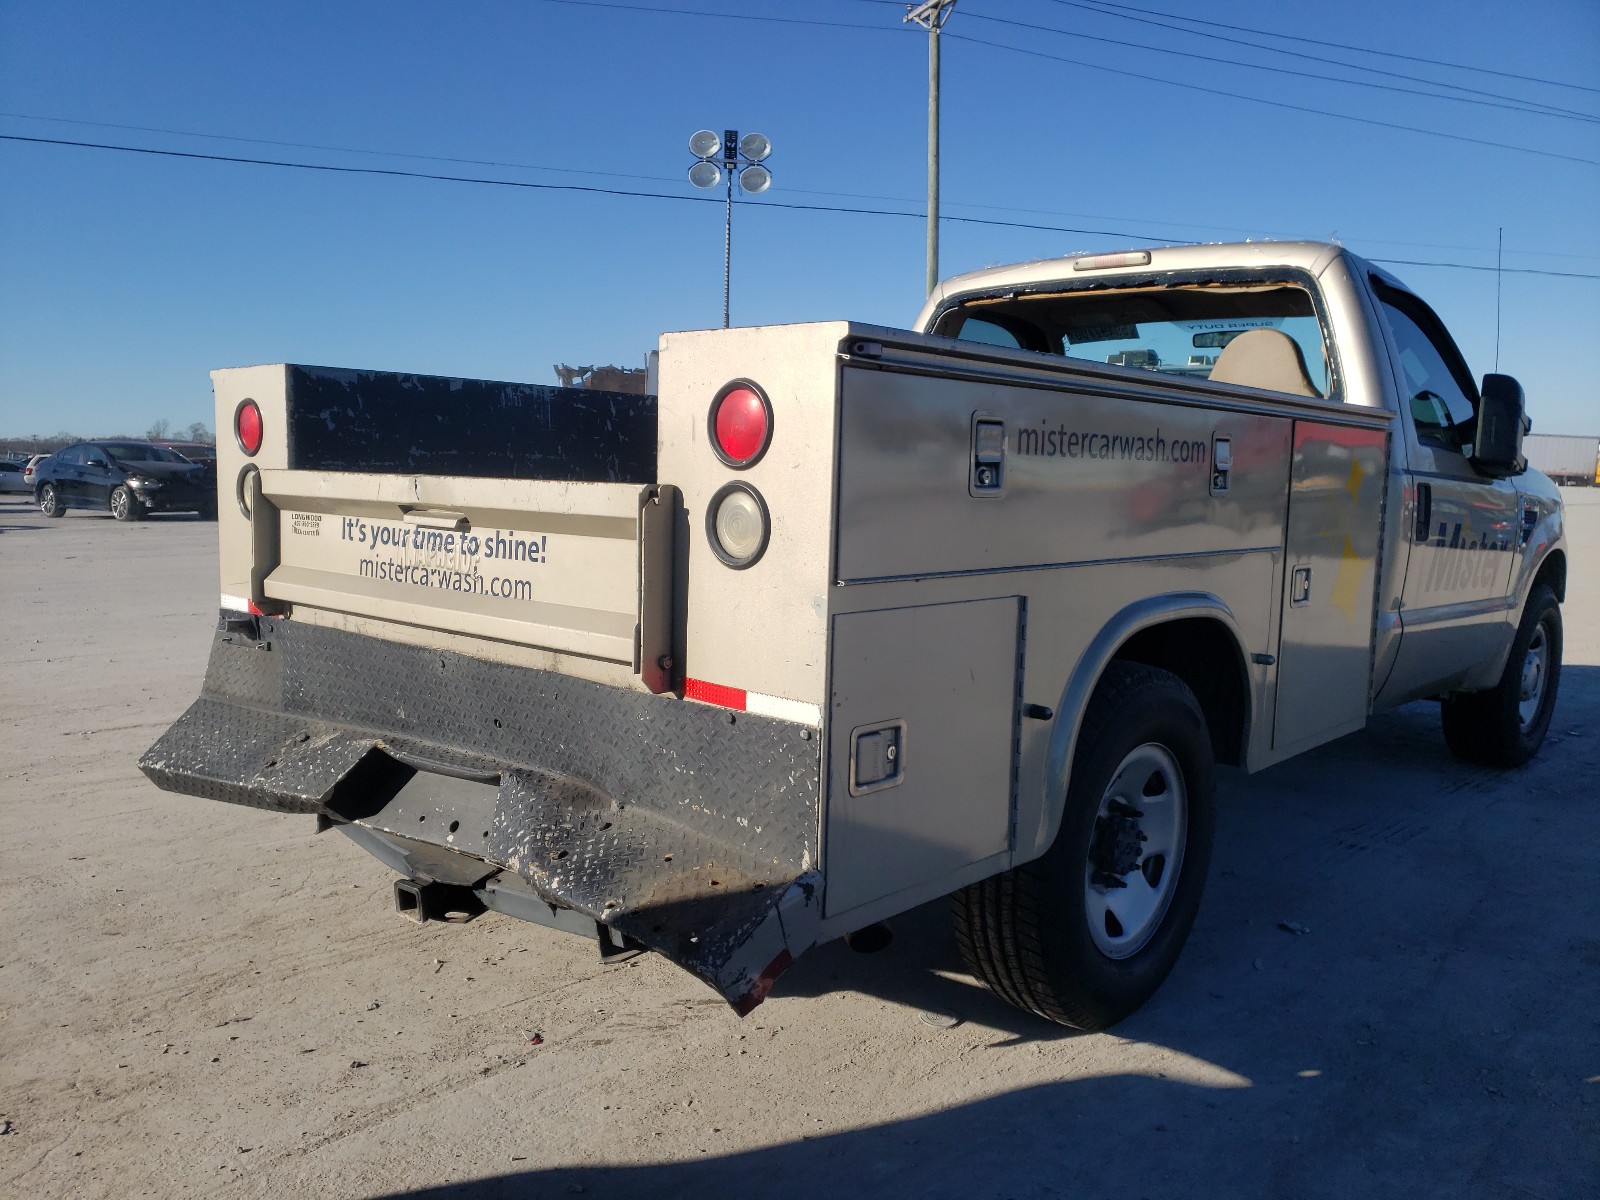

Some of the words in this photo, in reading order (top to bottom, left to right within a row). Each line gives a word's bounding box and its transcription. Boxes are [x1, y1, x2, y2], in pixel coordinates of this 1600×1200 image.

[1017, 418, 1206, 464] mistercarwash.com
[341, 516, 367, 543] It's
[369, 524, 414, 550] your
[413, 525, 455, 555] time
[460, 530, 479, 557] to
[484, 529, 547, 564] shine!
[359, 554, 532, 601] mistercarwash.com
